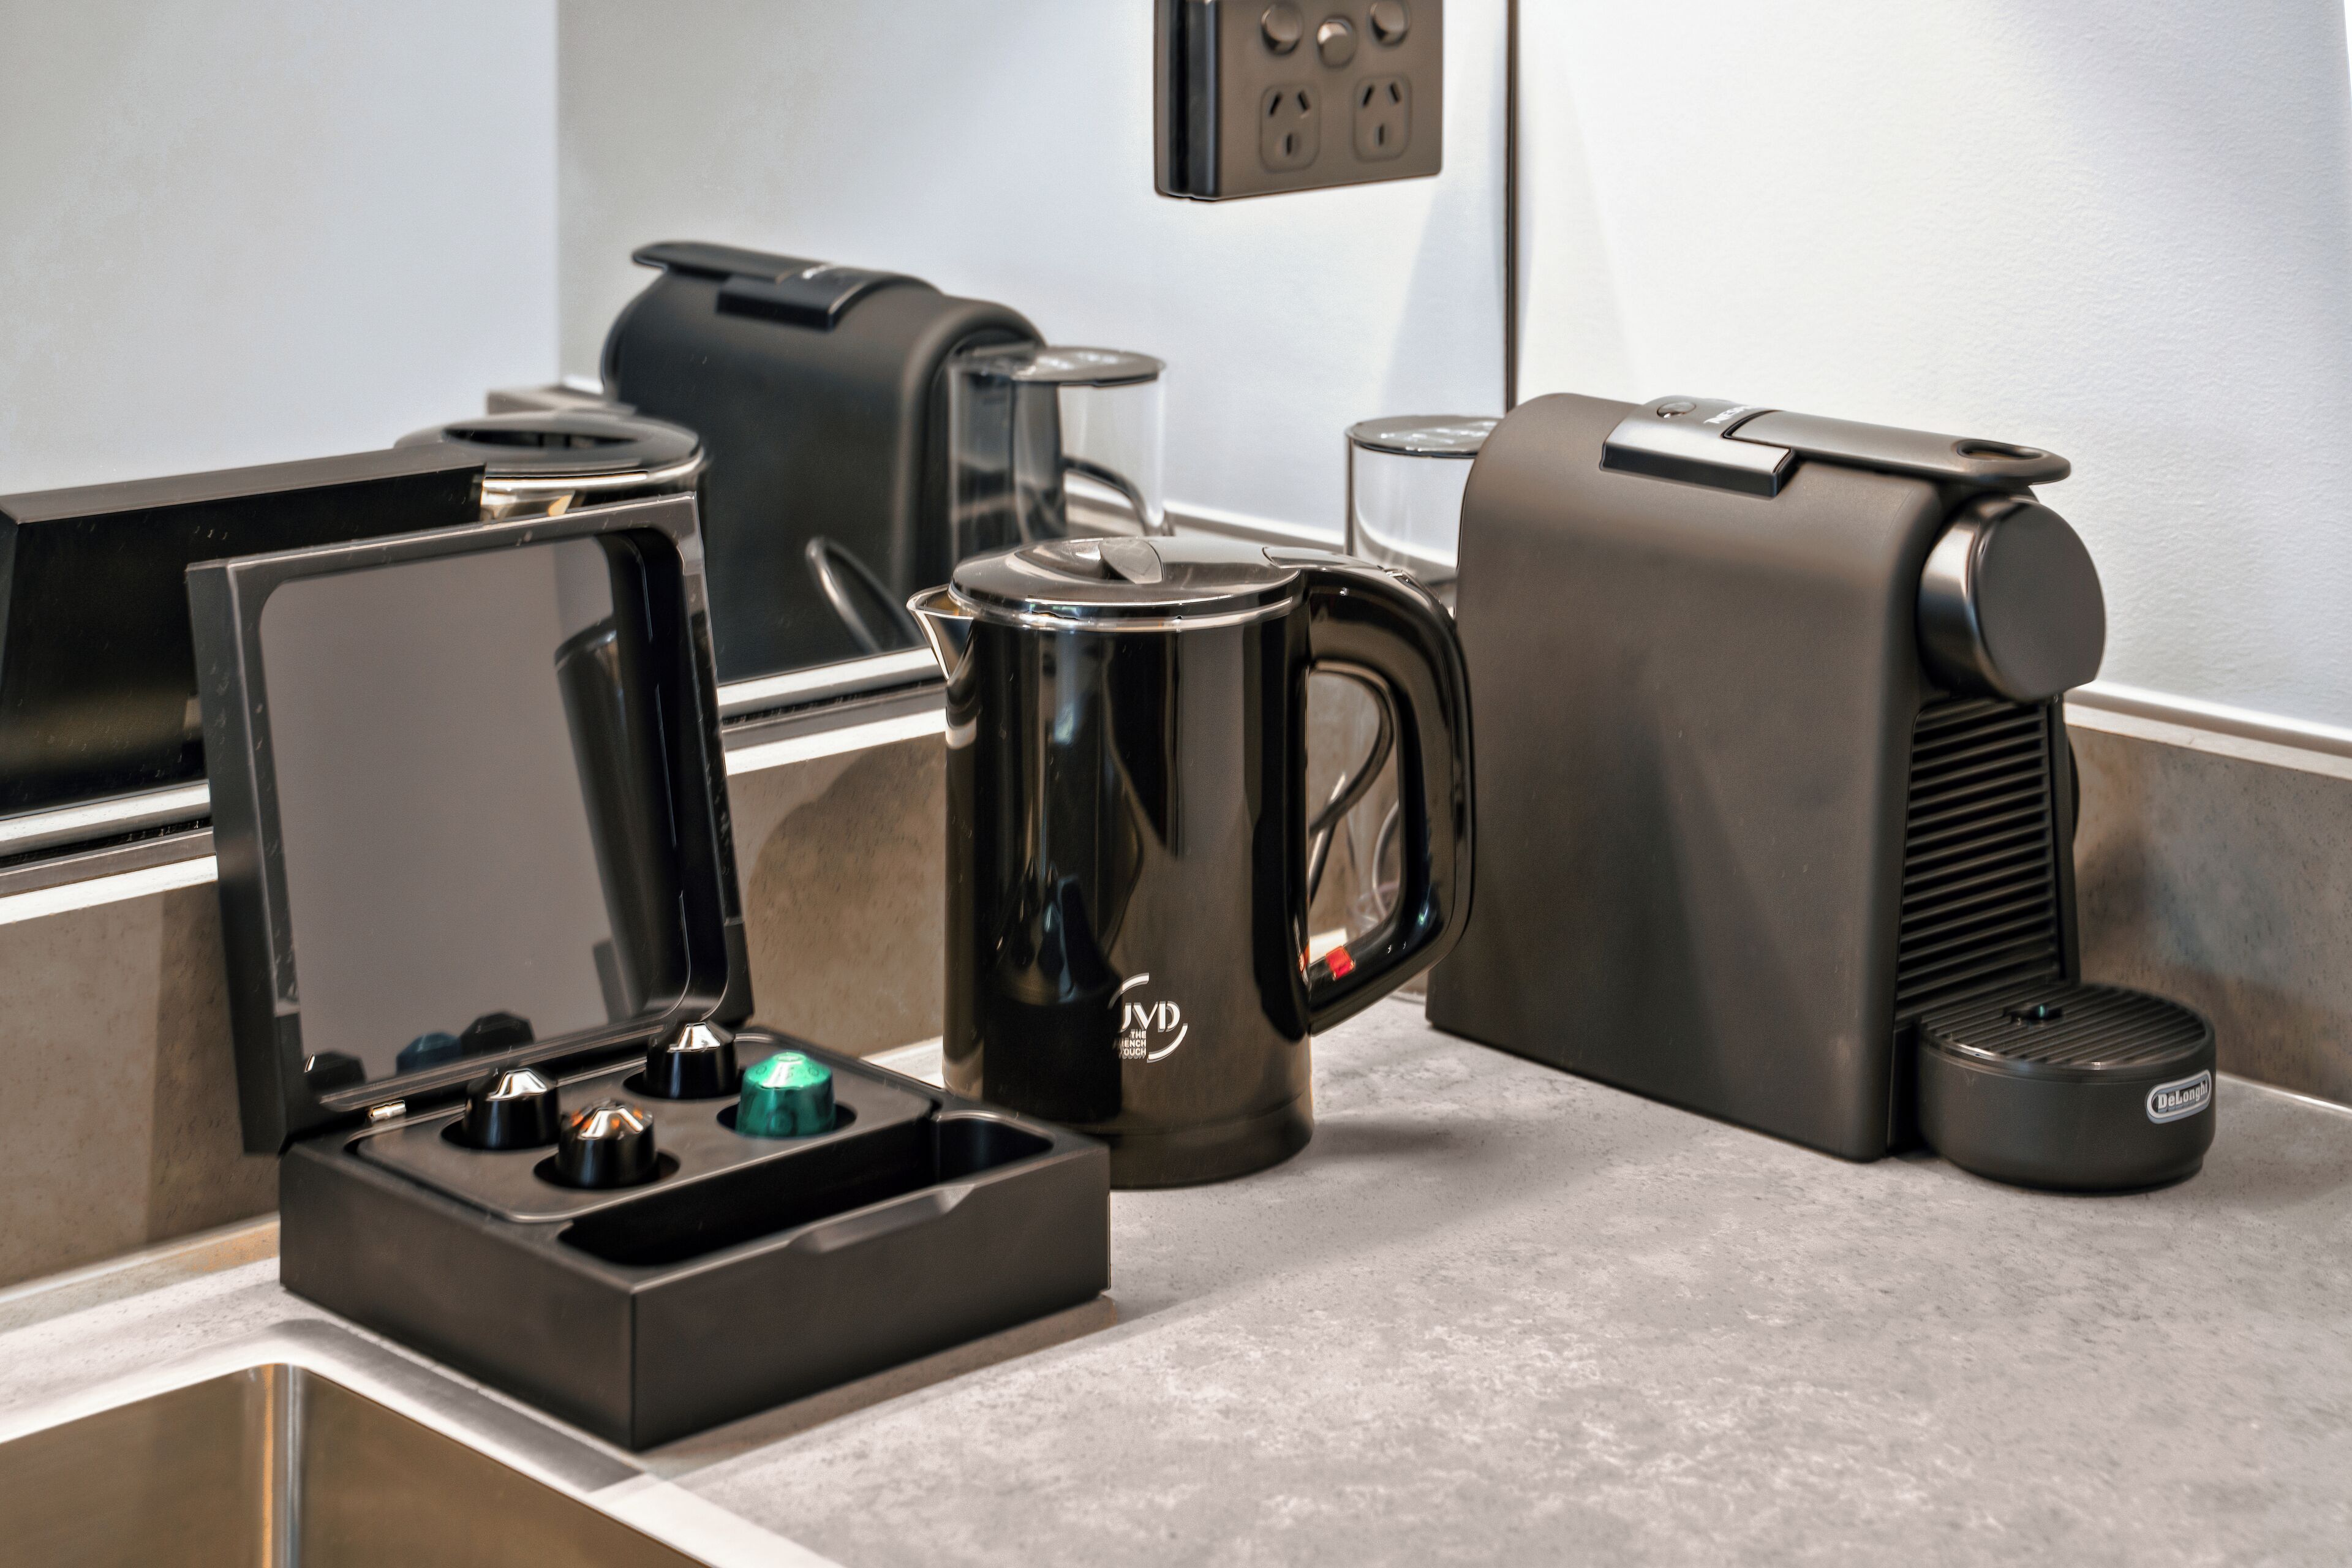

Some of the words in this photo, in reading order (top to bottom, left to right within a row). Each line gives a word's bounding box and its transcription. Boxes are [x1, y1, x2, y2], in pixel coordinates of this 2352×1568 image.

[1120, 1001, 1180, 1030] JVD
[1129, 1029, 1146, 1039] THE
[1117, 1038, 1147, 1048] ENCH
